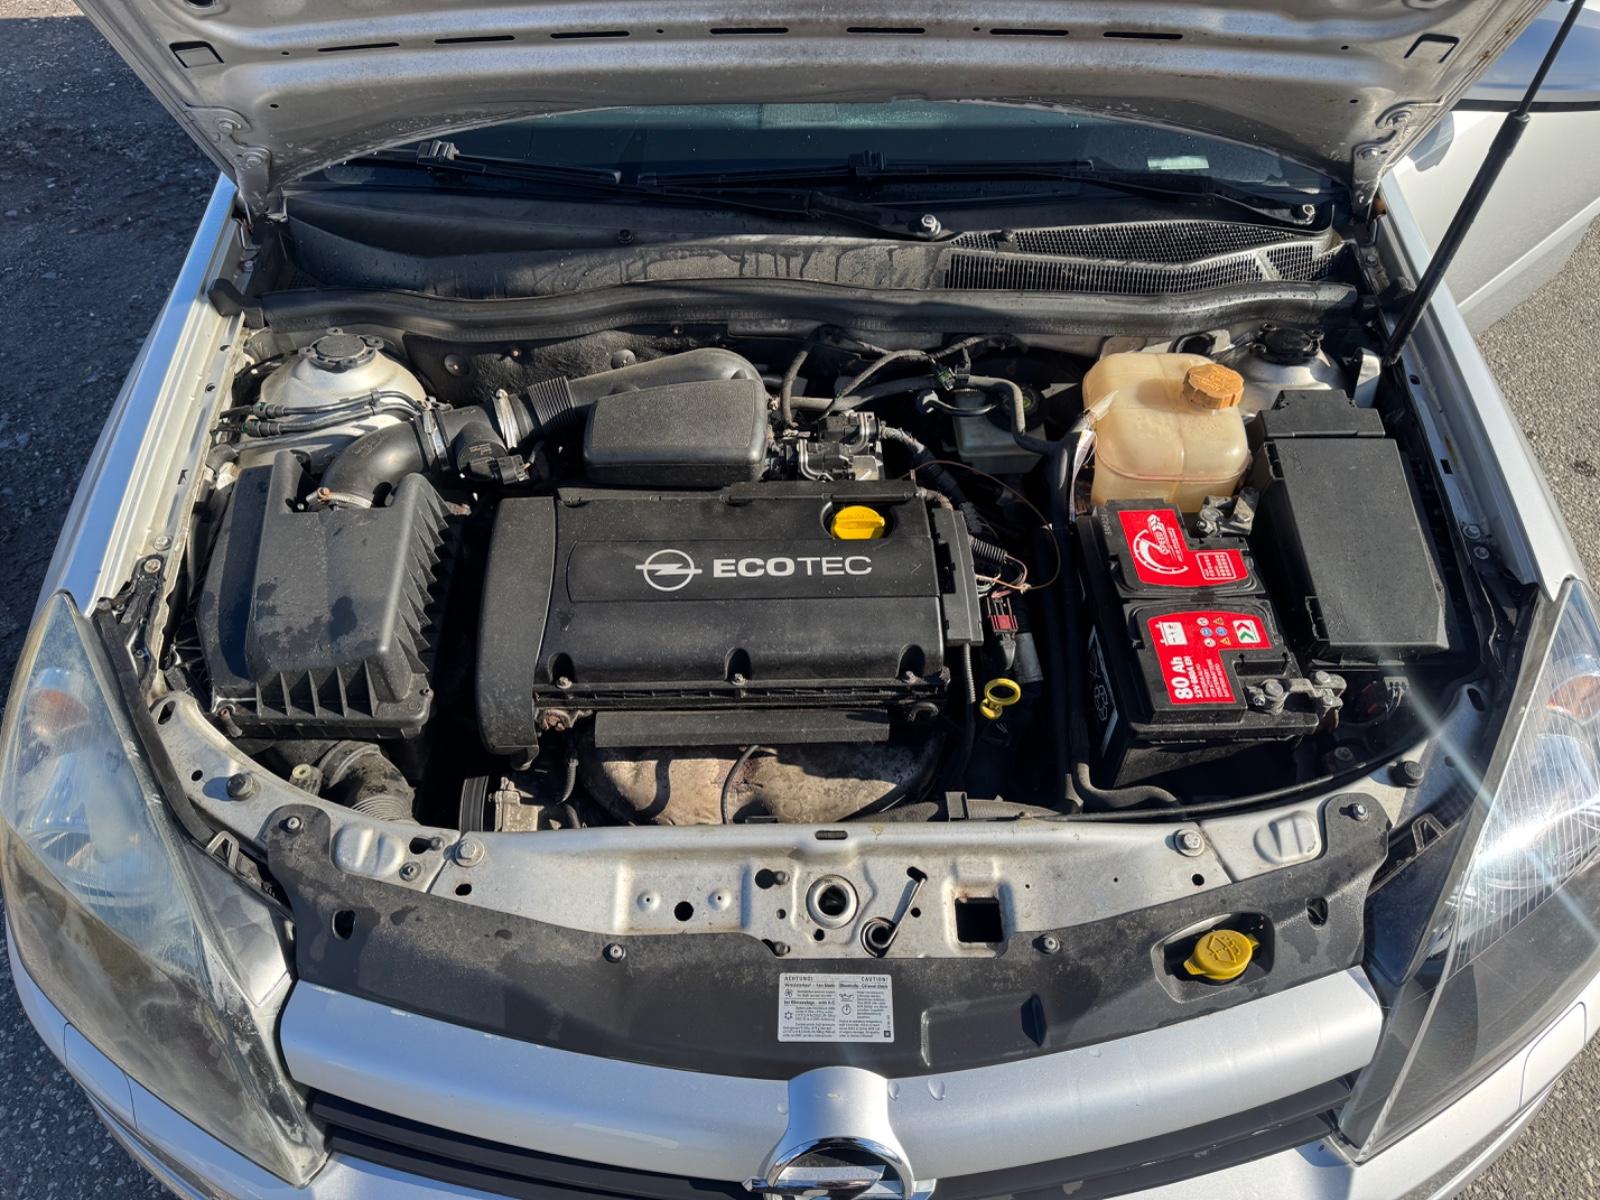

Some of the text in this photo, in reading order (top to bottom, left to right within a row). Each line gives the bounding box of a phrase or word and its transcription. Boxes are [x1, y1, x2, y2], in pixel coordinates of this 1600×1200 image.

[713, 556, 872, 578] ECOTEC
[1170, 656, 1193, 699] 80 Ah
[1191, 684, 1203, 698] 12V
